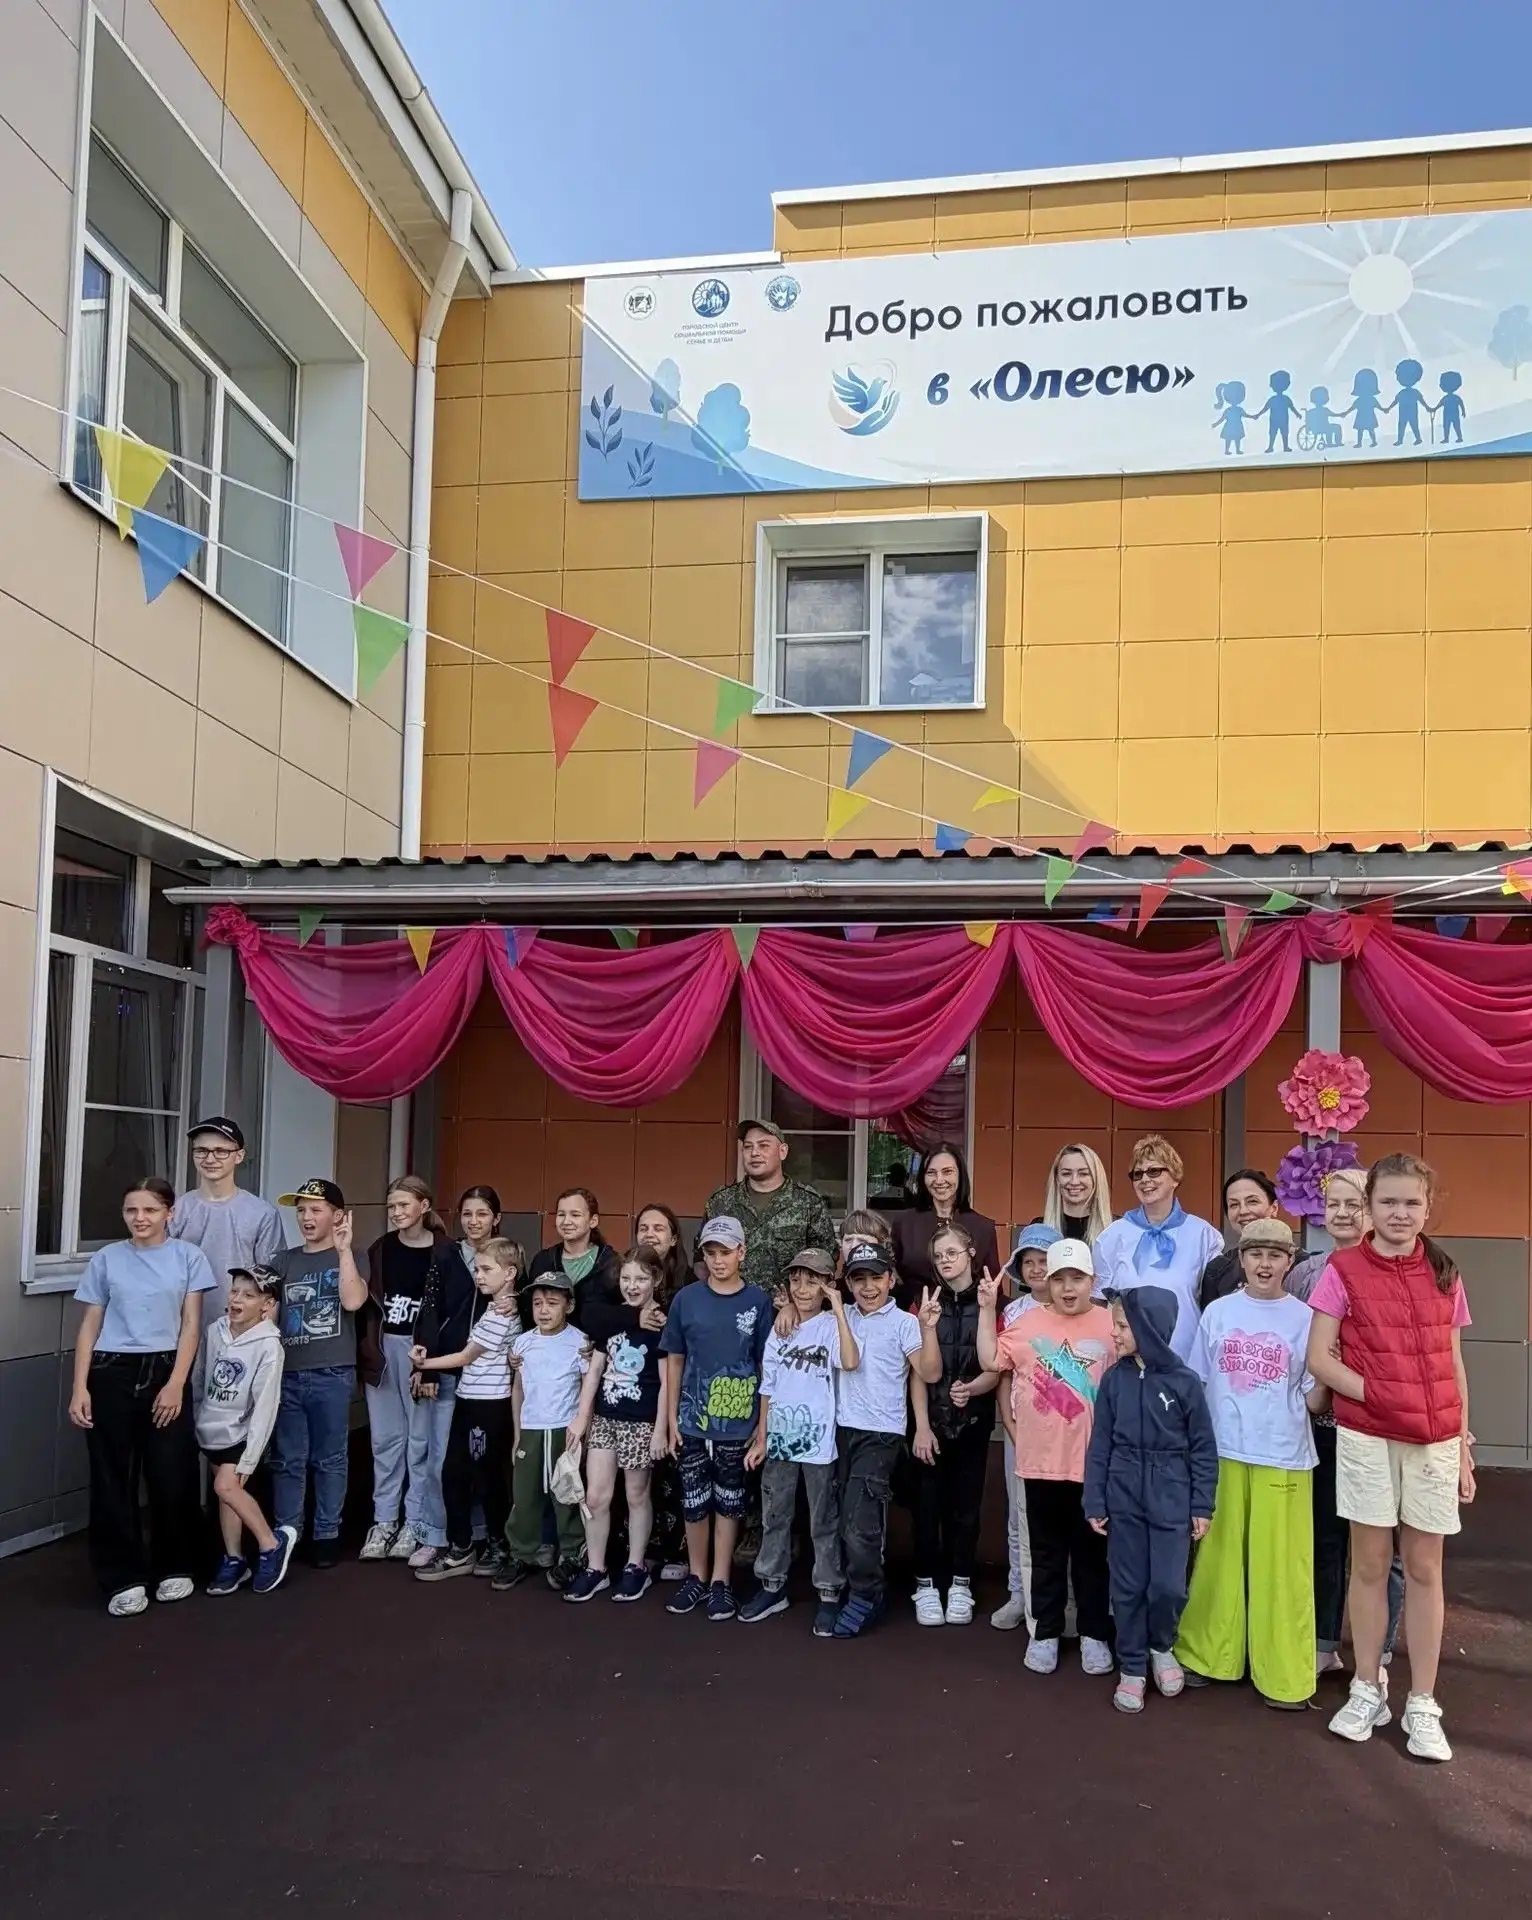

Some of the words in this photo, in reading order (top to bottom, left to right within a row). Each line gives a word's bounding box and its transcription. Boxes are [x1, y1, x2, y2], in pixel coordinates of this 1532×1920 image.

[824, 300, 963, 343] Добро
[976, 285, 1249, 328] пожаловать
[926, 371, 950, 406] в
[968, 360, 1196, 403] «Олесю»
[1219, 1356, 1288, 1384] amour
[1223, 1339, 1282, 1364] merci
